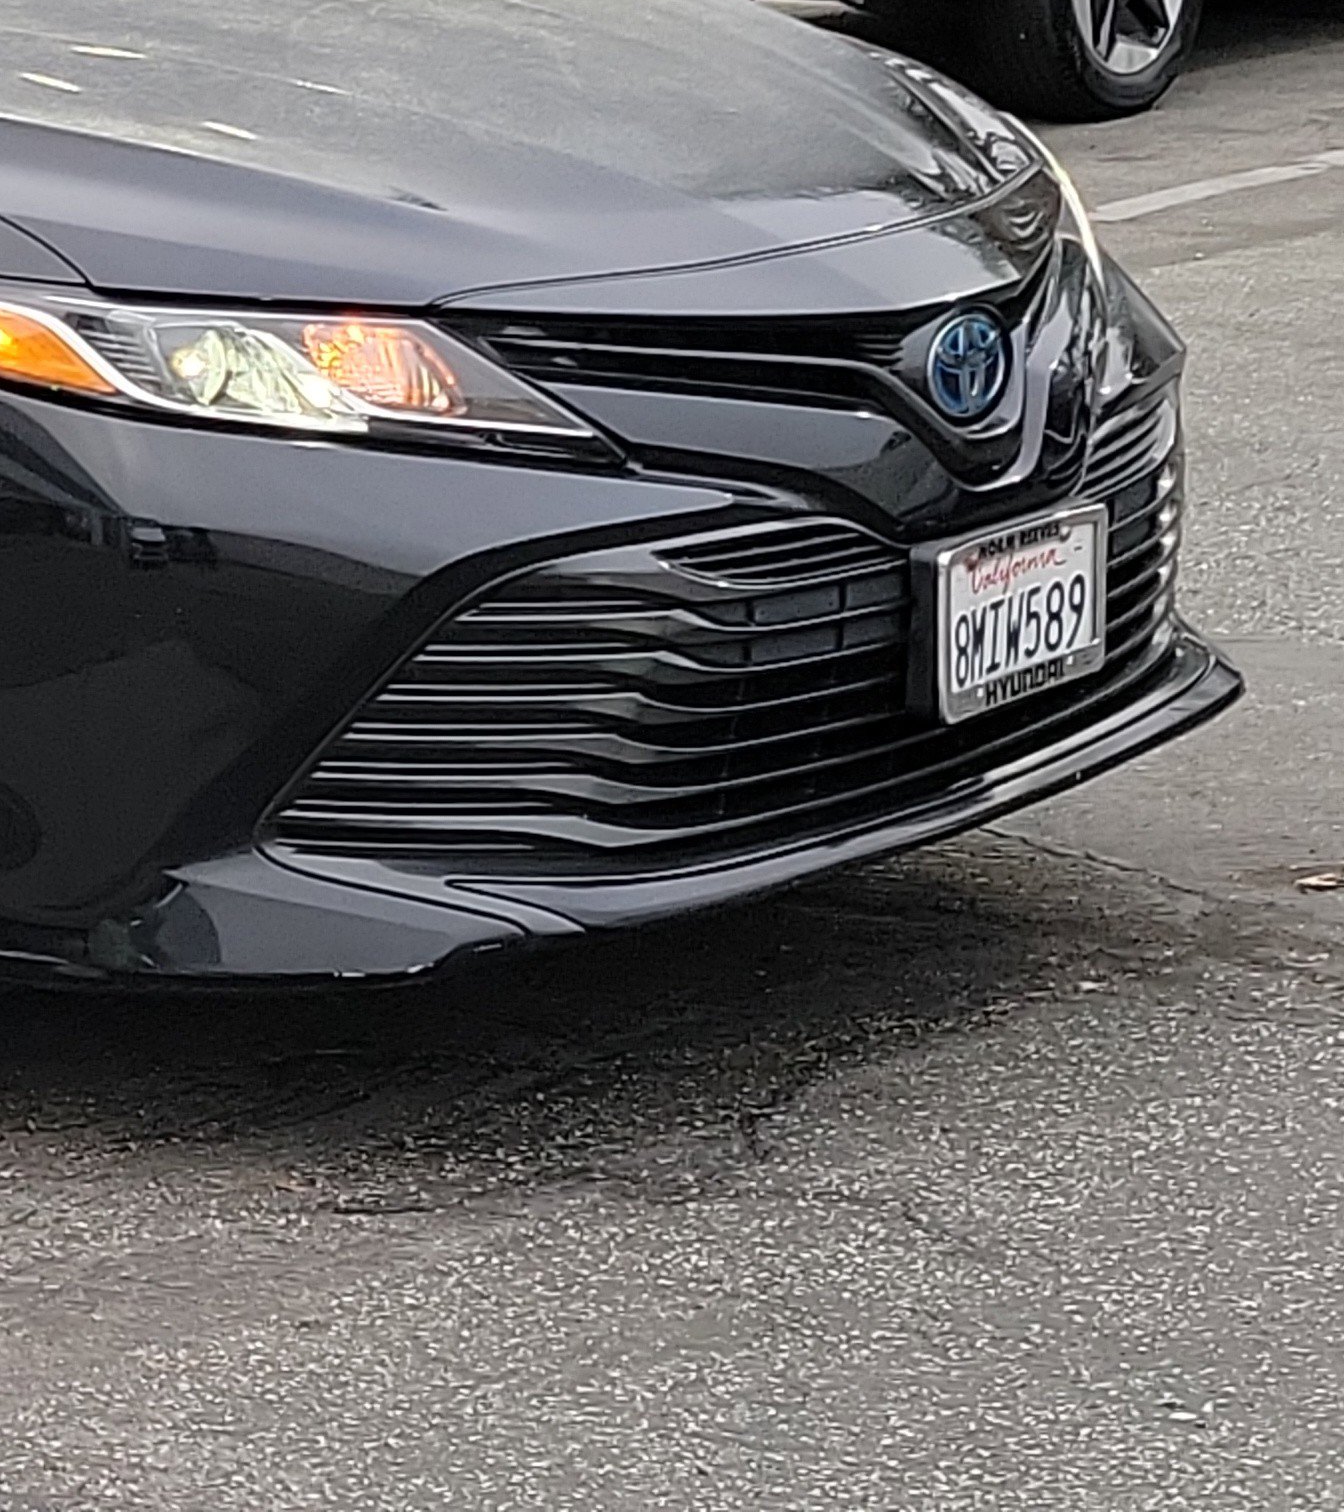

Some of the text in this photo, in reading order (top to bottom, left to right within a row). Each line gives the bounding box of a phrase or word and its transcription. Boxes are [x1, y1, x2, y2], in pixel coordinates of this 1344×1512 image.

[972, 547, 1066, 595] California
[954, 574, 1086, 688] 8MIW589
[985, 660, 1064, 707] HYUNDAI
